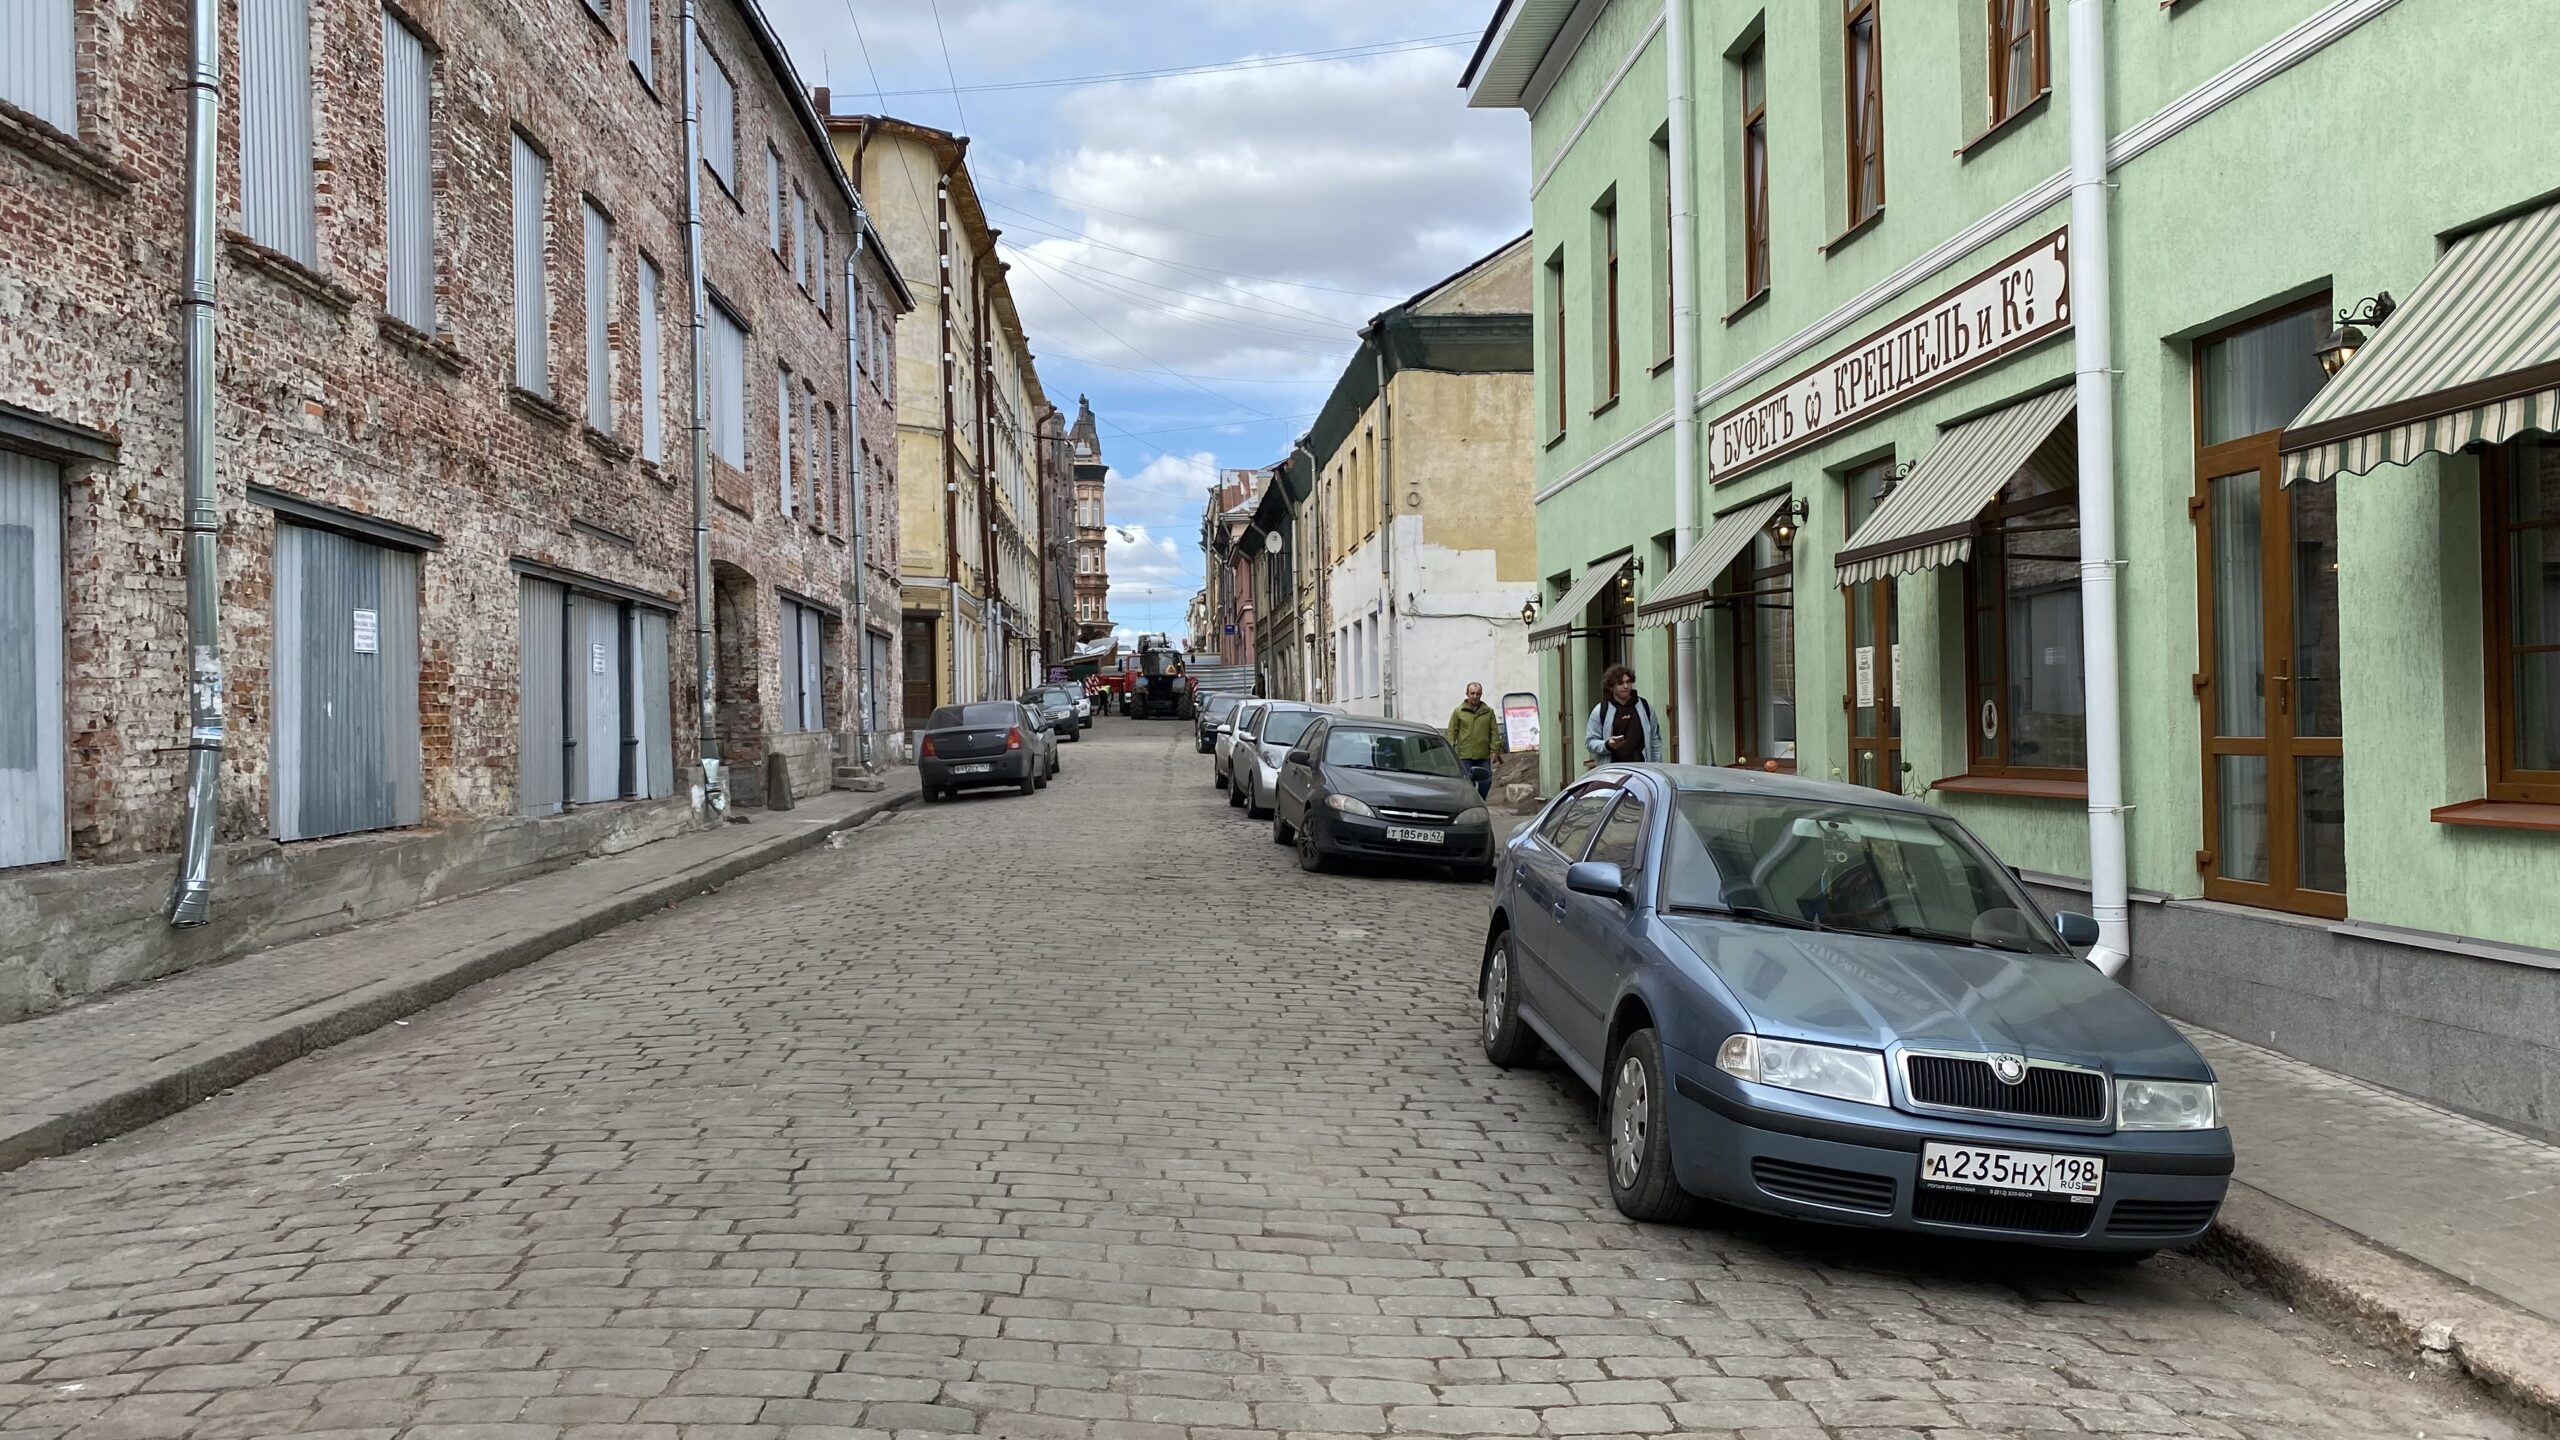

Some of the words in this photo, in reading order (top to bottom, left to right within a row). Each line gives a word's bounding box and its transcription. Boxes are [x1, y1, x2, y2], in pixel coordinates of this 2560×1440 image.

[1723, 394, 1794, 467] БУФЕТЪ
[1833, 302, 1970, 416] КРЕНДЕЛЬ
[2054, 1158, 2095, 1182] 198
[2060, 1180, 2081, 1190] RUS
